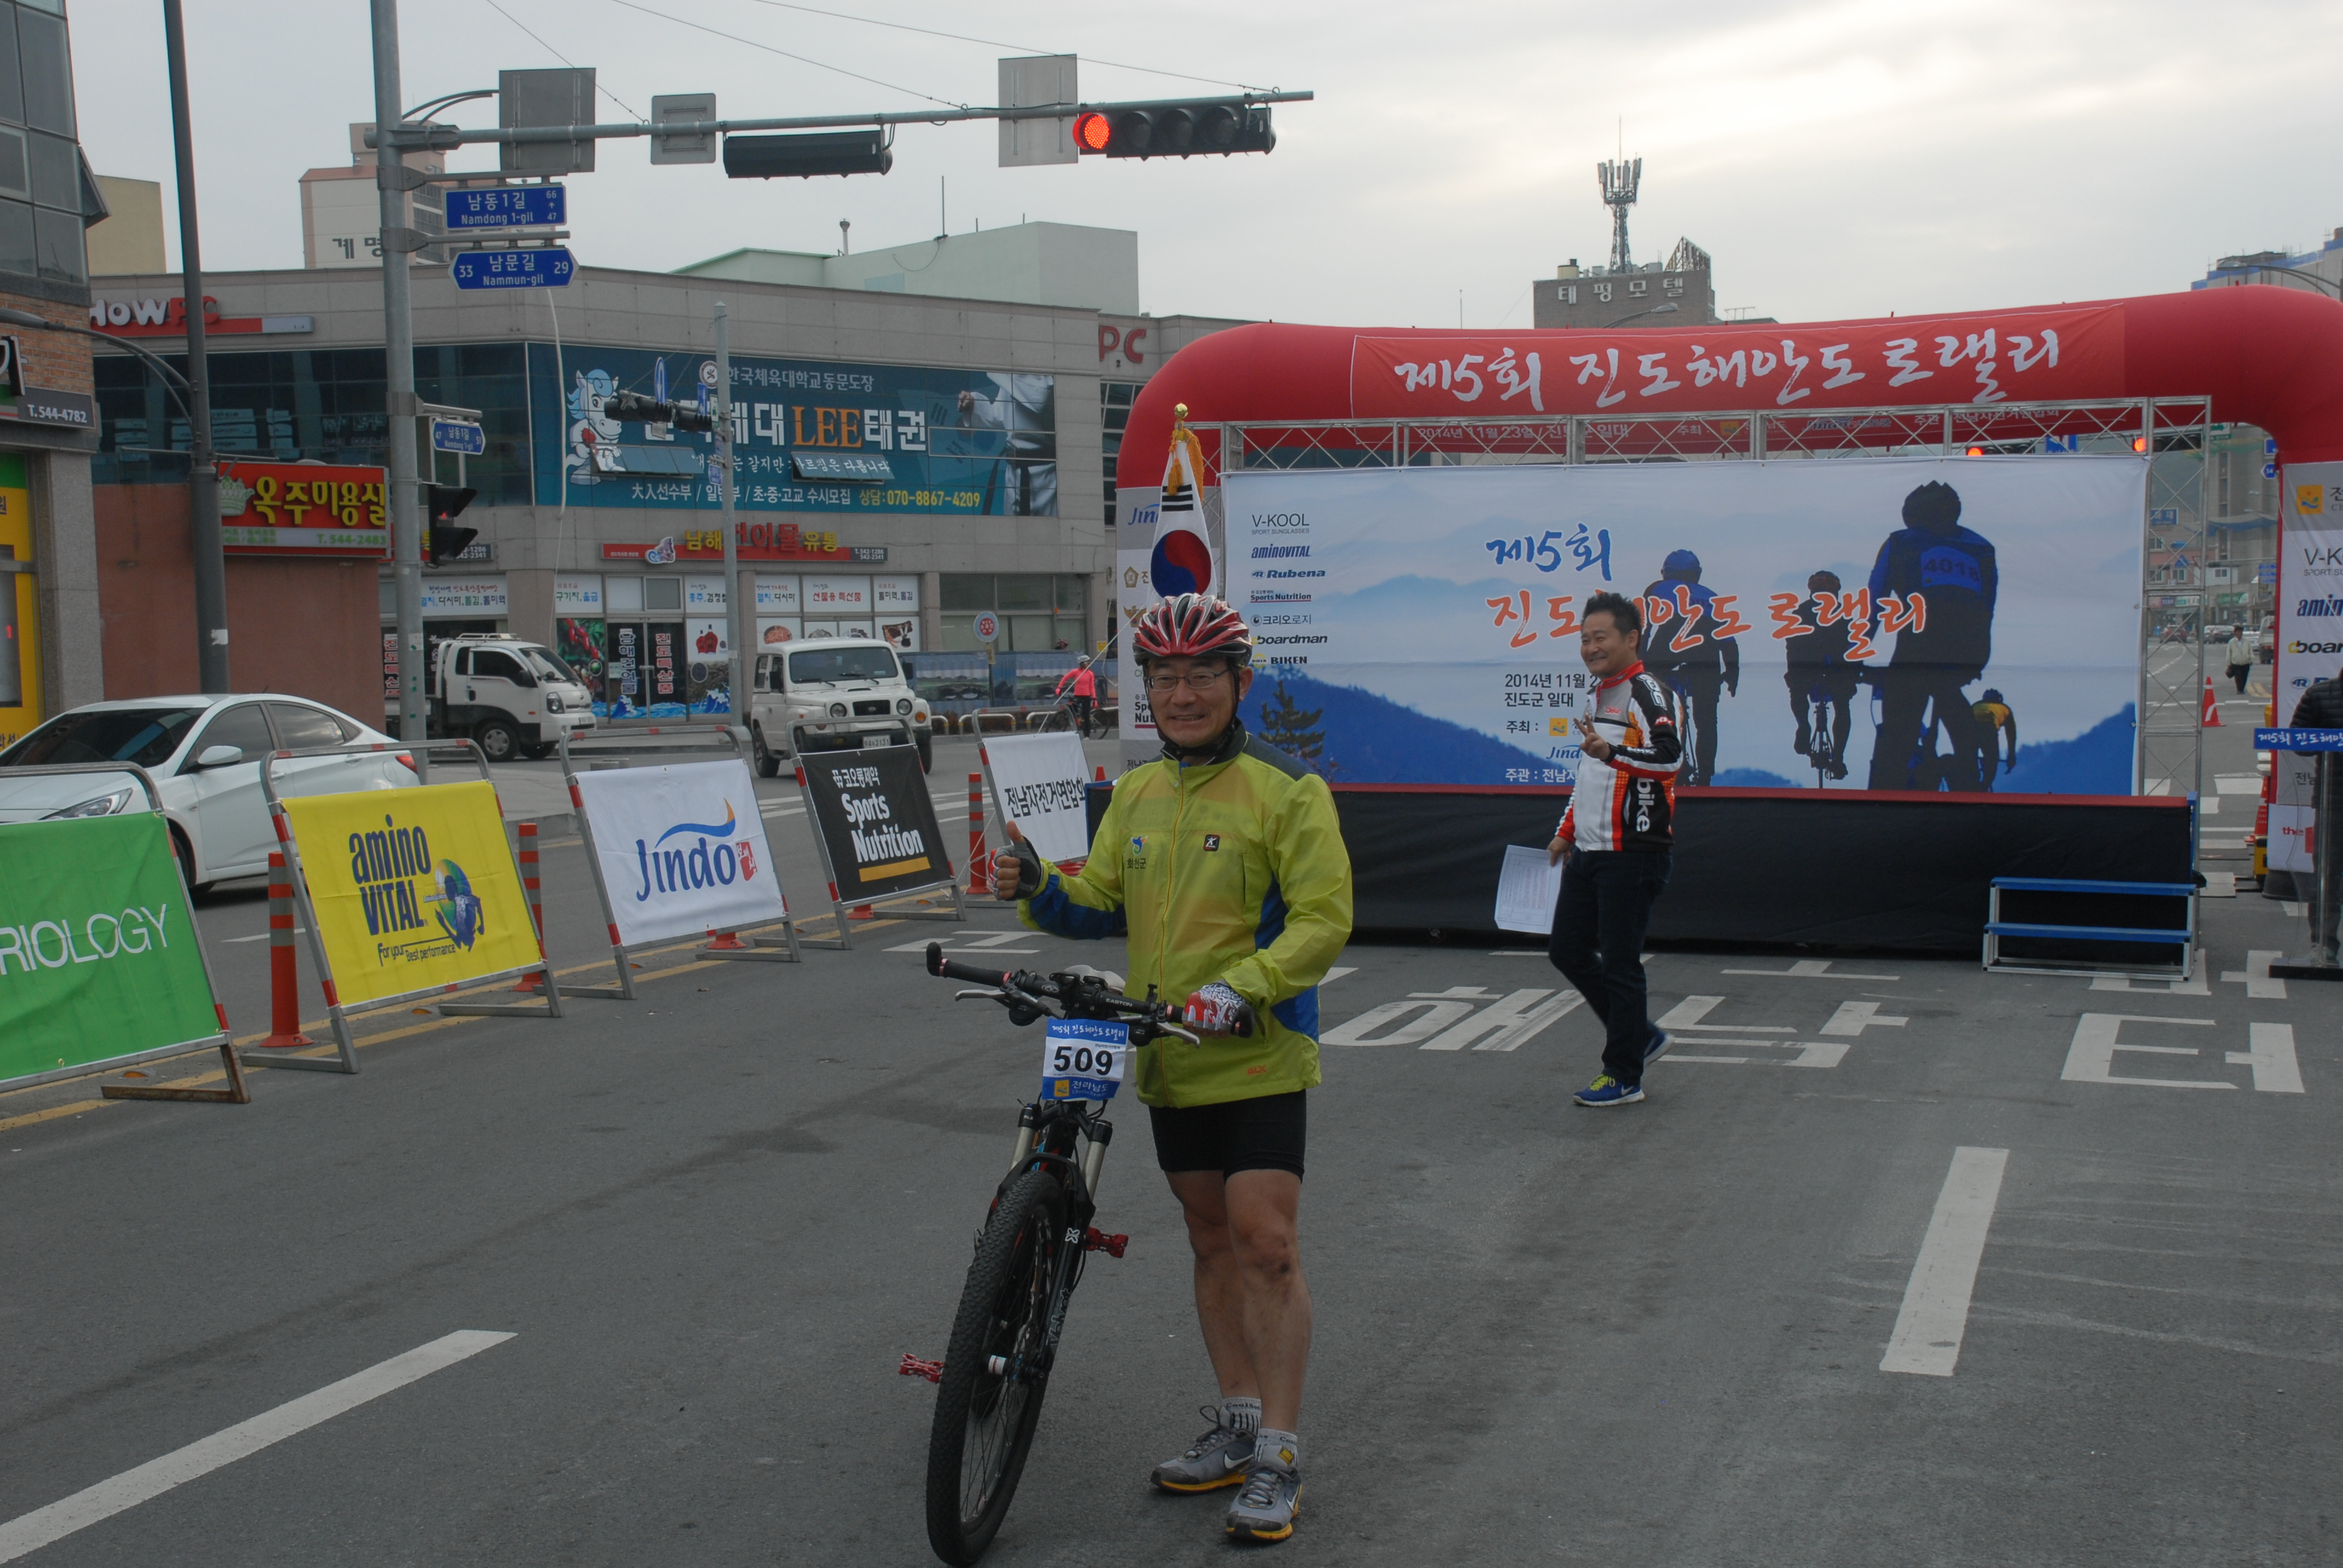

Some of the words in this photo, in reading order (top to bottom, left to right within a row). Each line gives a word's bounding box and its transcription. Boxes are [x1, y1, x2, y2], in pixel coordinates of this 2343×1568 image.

[546, 191, 557, 199] 66
[461, 214, 508, 225] Namdong
[512, 212, 534, 224] 1-gil
[547, 212, 557, 221] 47
[489, 253, 536, 272] 남문길
[554, 261, 569, 274] 29
[459, 265, 473, 278] 33
[483, 274, 544, 286] Nammun-gil
[1098, 324, 1147, 364] PC
[1395, 345, 1544, 411] 제5회
[253, 476, 385, 526] 옥주미용실
[1251, 513, 1310, 528] V-KOOL
[1486, 519, 1612, 582] 제5회
[1266, 569, 1326, 579] Rubena
[1262, 614, 1312, 625] 크리오로지
[1486, 584, 1752, 653] 진도안도
[1271, 656, 1308, 665] BIKEN
[1504, 673, 1553, 688] 2014년
[1556, 673, 1586, 688] 11월
[1504, 693, 1544, 707] 진도군
[1506, 720, 1530, 734] 주최
[1505, 768, 1530, 782] 주관
[841, 792, 891, 832] Sports
[349, 814, 432, 885] amino
[850, 827, 925, 863] Nutrition
[635, 837, 736, 902] Jindo
[359, 879, 425, 936] VITAL
[405, 948, 420, 962] Best
[419, 943, 456, 962] performance
[1106, 998, 1133, 1008] EASTON
[1053, 1045, 1113, 1076] 509
